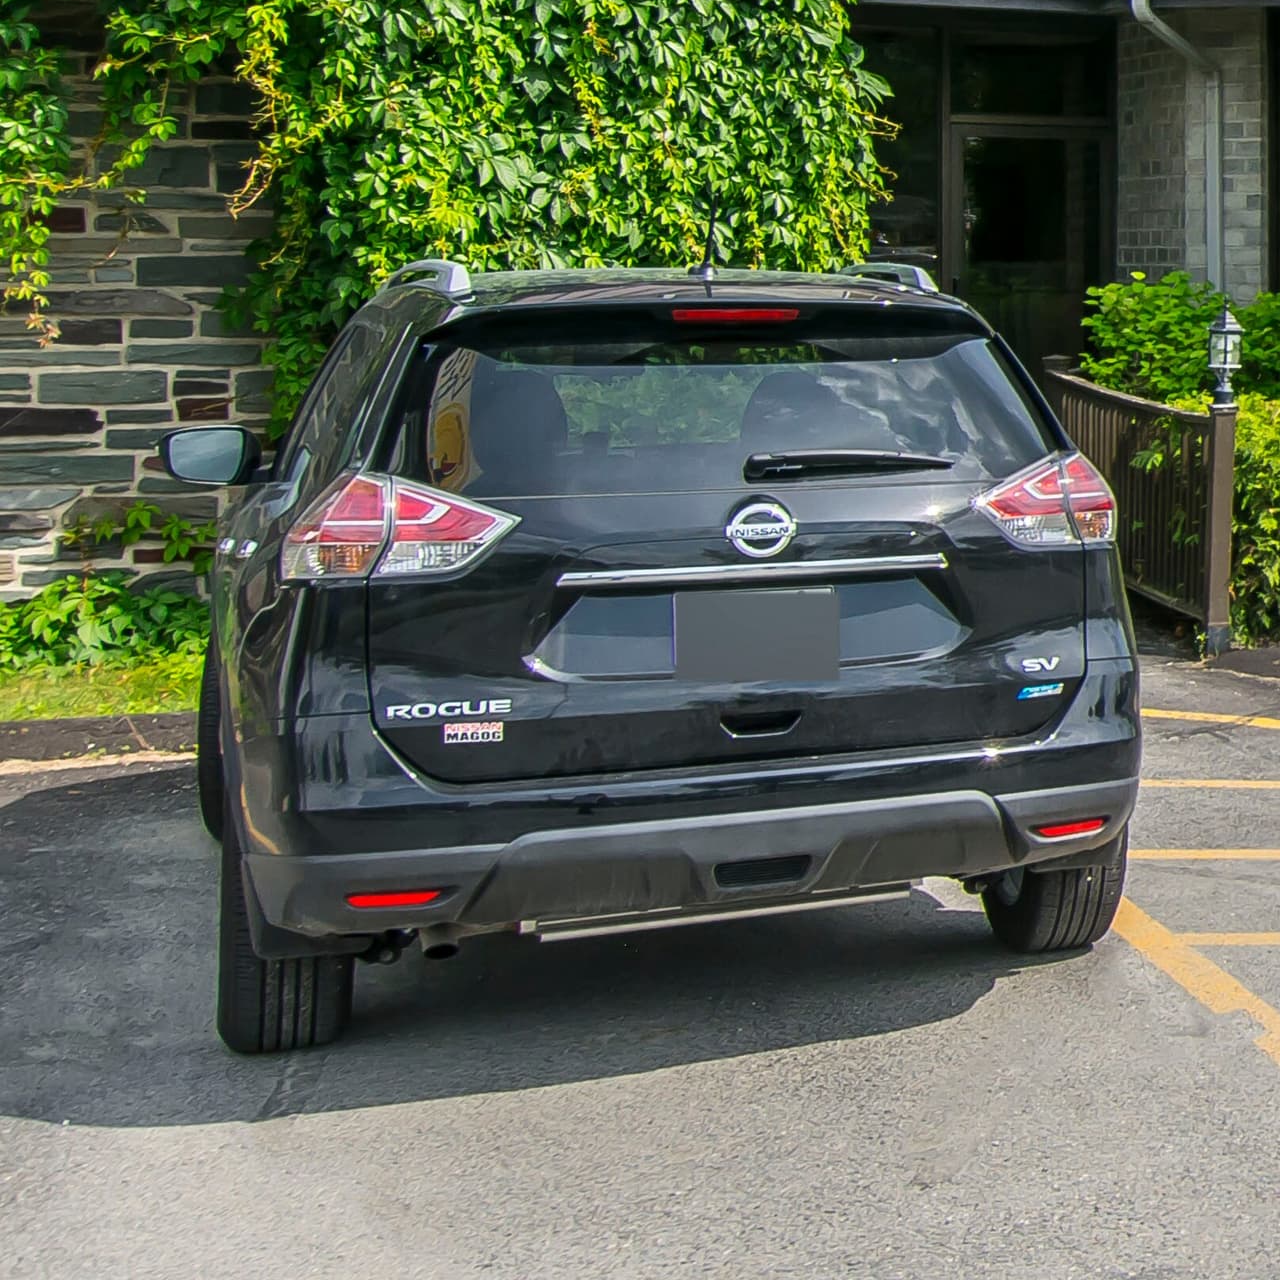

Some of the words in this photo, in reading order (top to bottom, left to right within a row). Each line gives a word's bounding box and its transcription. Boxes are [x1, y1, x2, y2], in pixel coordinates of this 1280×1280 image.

[735, 526, 789, 536] NISSAN
[1022, 656, 1060, 672] SV
[386, 699, 512, 720] ROGUE
[445, 722, 503, 732] NISSAN
[446, 731, 502, 742] MAGOG
